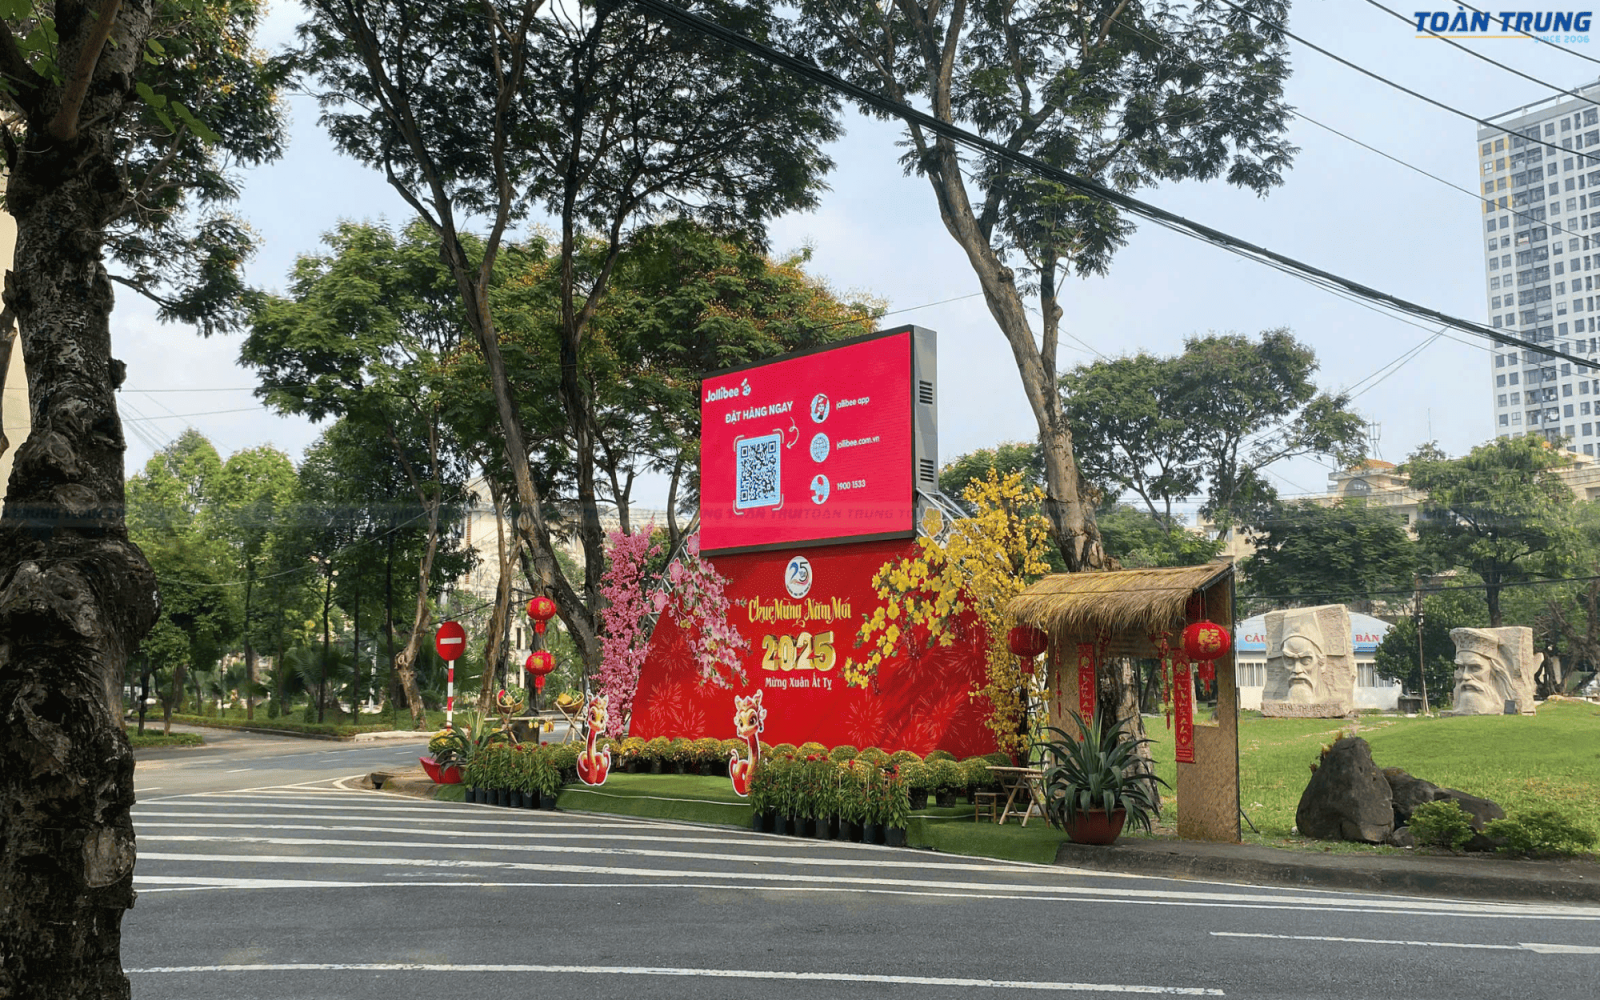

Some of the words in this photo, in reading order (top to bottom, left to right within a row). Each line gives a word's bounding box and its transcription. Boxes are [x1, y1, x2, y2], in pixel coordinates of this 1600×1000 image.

[705, 386, 739, 403] Jollibee
[857, 396, 870, 406] app
[743, 406, 767, 420] HÀNG
[769, 401, 793, 415] NGAY
[836, 436, 880, 450] jollibee.com.vn
[836, 481, 851, 491] 1900
[851, 479, 866, 489] 1533
[748, 596, 774, 624] Chúc
[804, 597, 831, 621] Năm
[1356, 632, 1379, 642] BÀN
[762, 630, 836, 671] 2025
[765, 676, 787, 690] Mừng
[789, 676, 809, 688] Xuân
